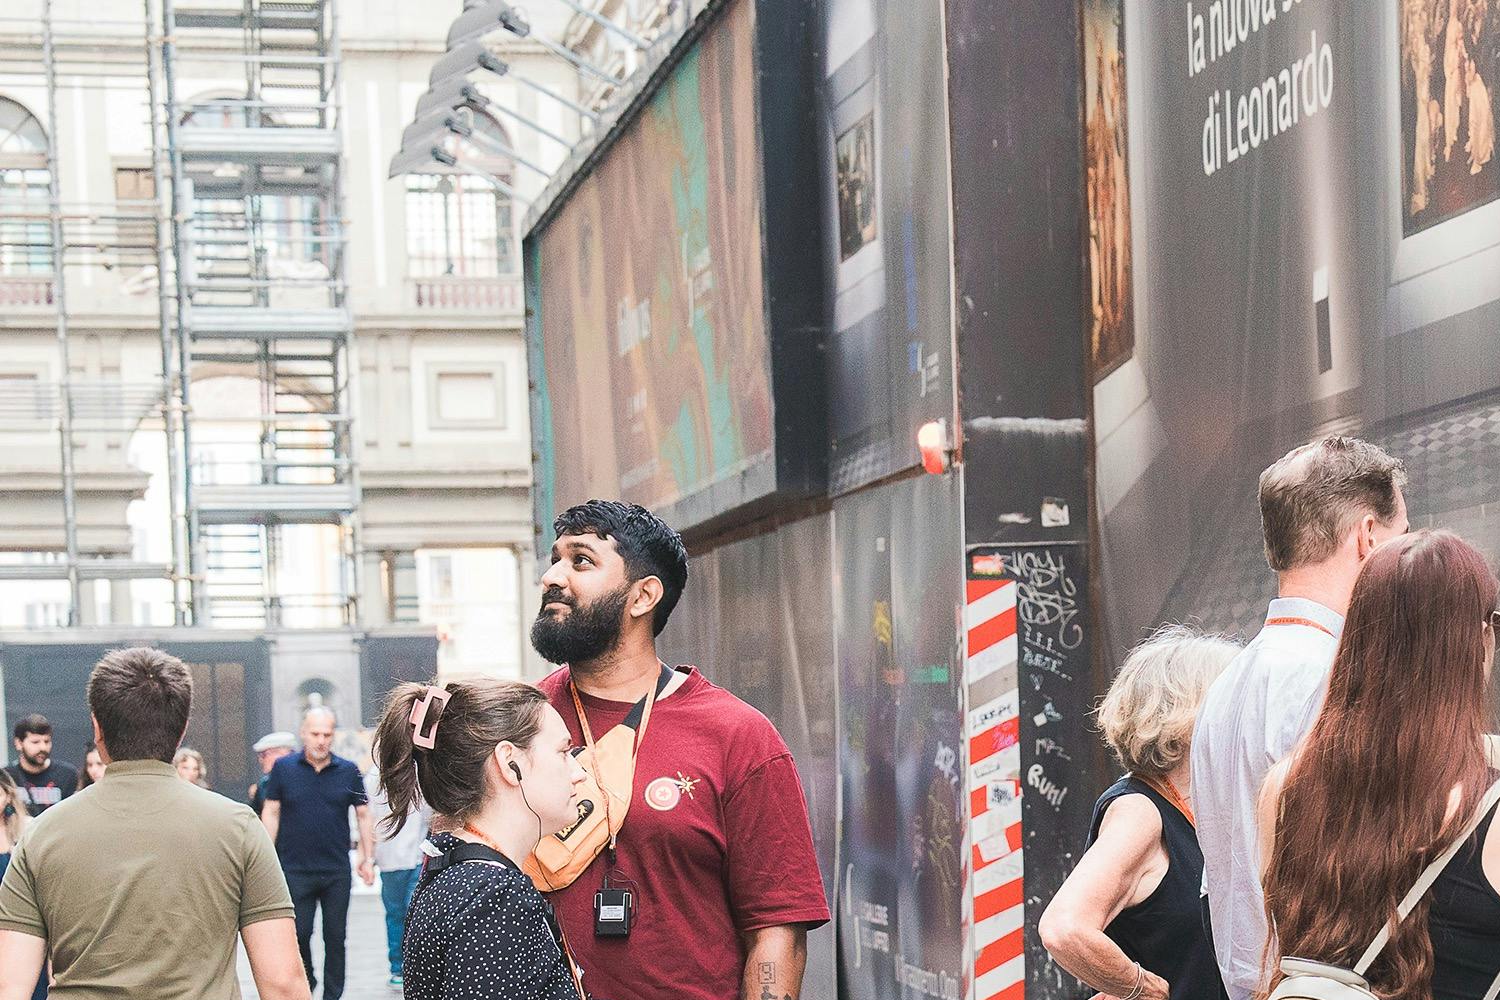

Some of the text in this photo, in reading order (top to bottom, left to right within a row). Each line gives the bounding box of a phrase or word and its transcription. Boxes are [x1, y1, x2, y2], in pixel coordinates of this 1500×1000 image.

[1187, 1, 1206, 77] la
[1203, 29, 1334, 176] di Leonardo
